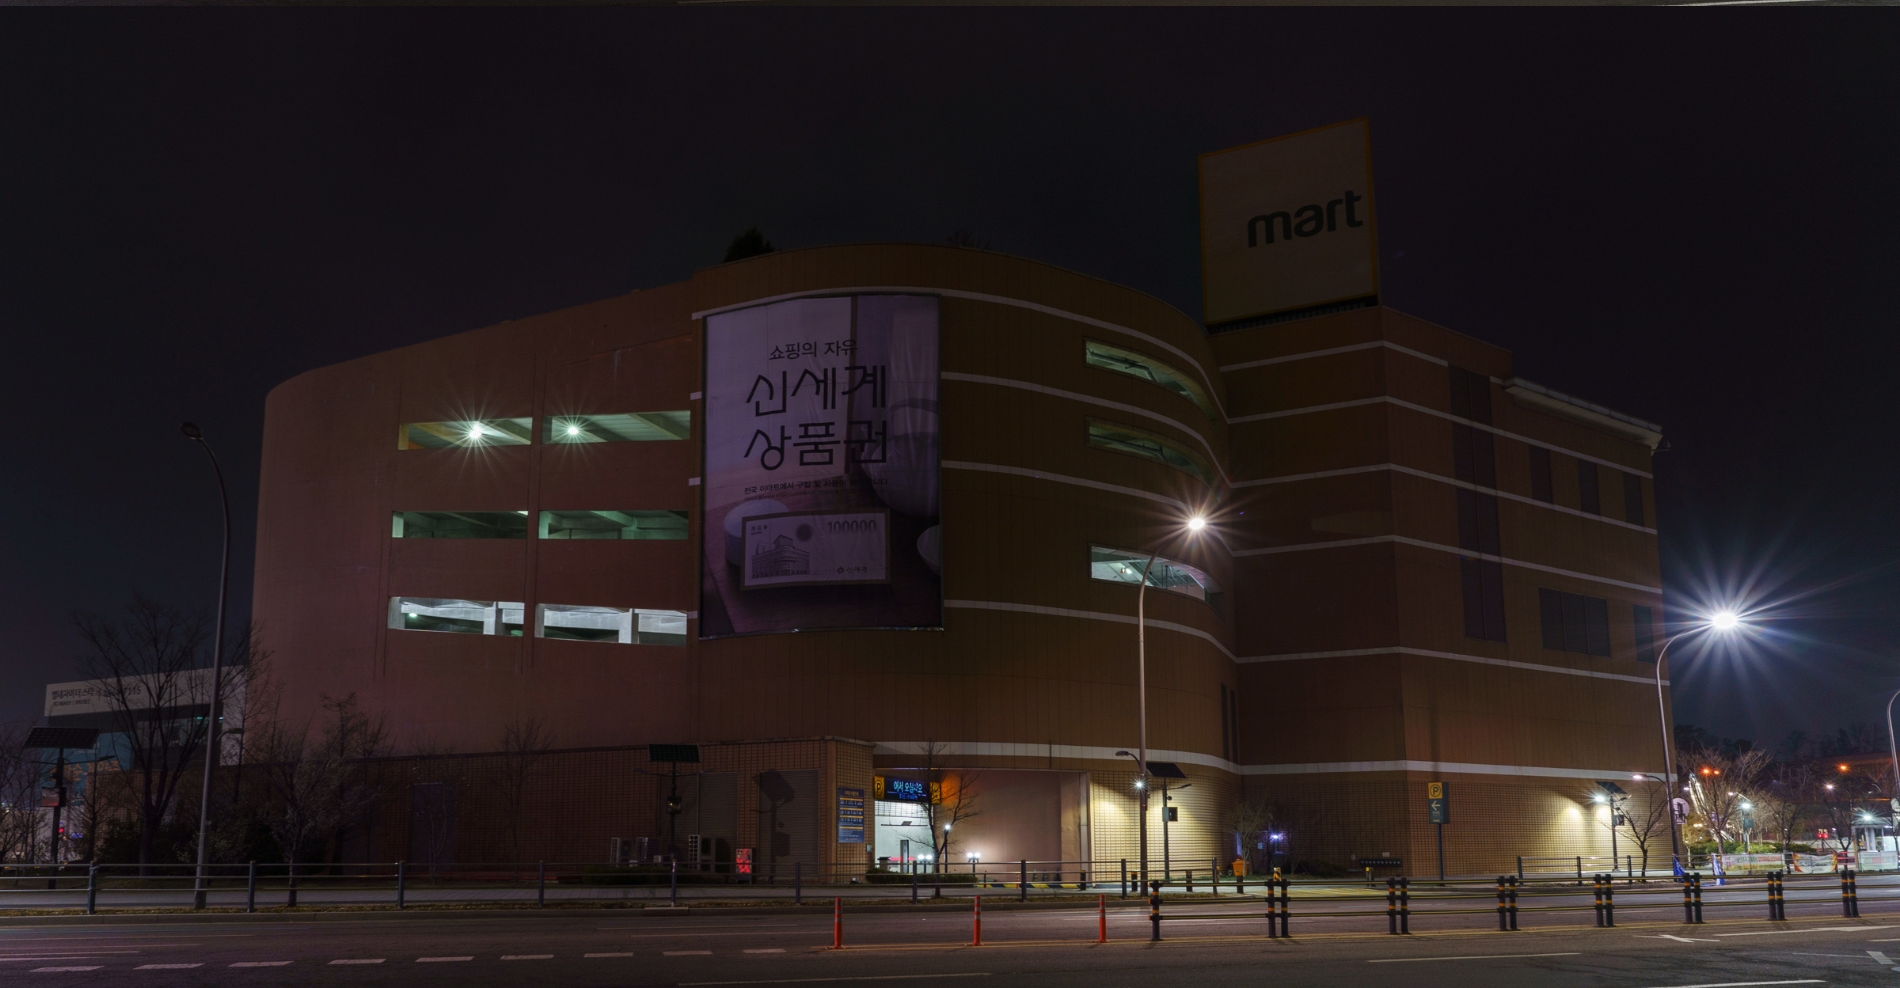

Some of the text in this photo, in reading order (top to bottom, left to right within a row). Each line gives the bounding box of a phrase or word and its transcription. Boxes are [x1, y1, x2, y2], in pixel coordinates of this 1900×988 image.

[769, 339, 858, 361] 쇼핑의 자유
[745, 365, 887, 417] 신세계
[743, 420, 887, 471] 상품권
[759, 482, 794, 492] 이마트에서
[826, 519, 877, 535] 100000
[893, 780, 904, 792] 어서
